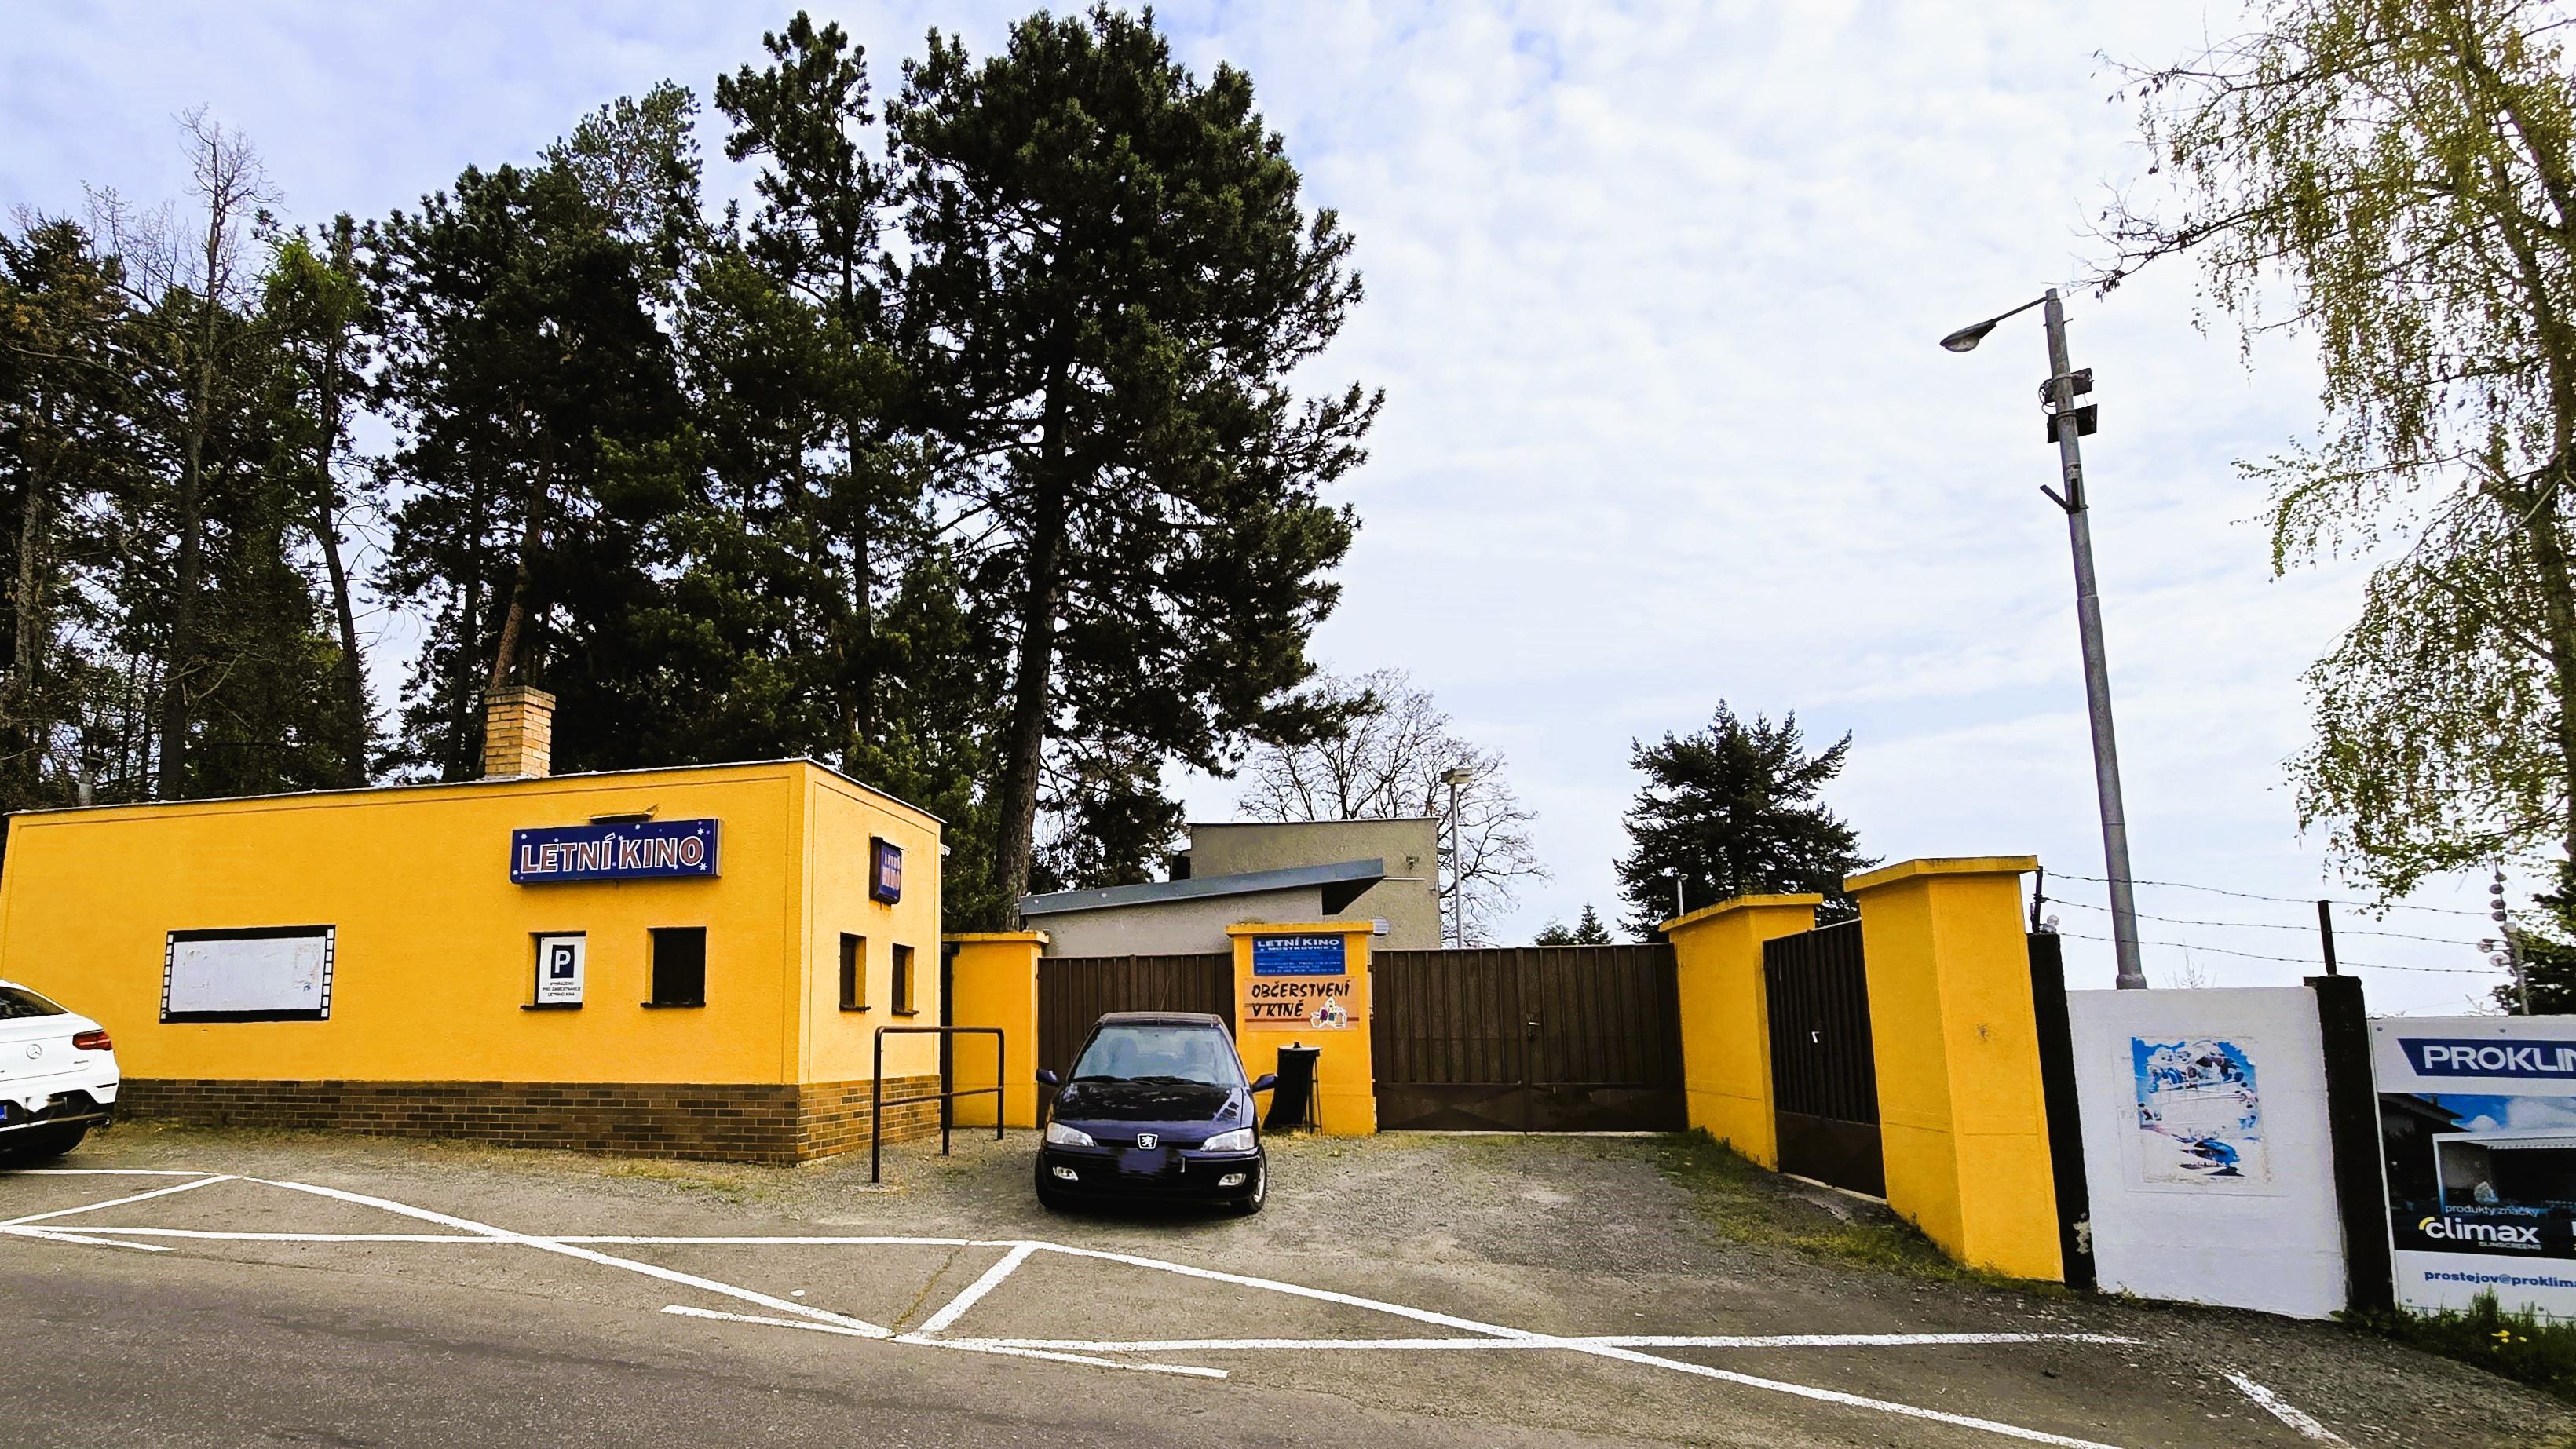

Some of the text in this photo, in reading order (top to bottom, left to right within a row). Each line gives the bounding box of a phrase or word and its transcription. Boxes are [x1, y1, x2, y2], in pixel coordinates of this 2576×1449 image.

[521, 832, 704, 874] LETNÍ KINO
[1257, 936, 1299, 947] LETNÍ
[554, 950, 571, 973] P
[1251, 979, 1351, 998] OBČERSTVENÍ
[1252, 999, 1304, 1017] V KINĚ
[2446, 1204, 2495, 1216] produkty
[2425, 1217, 2541, 1243] climax
[2424, 1271, 2576, 1288] prostejov@proklim
